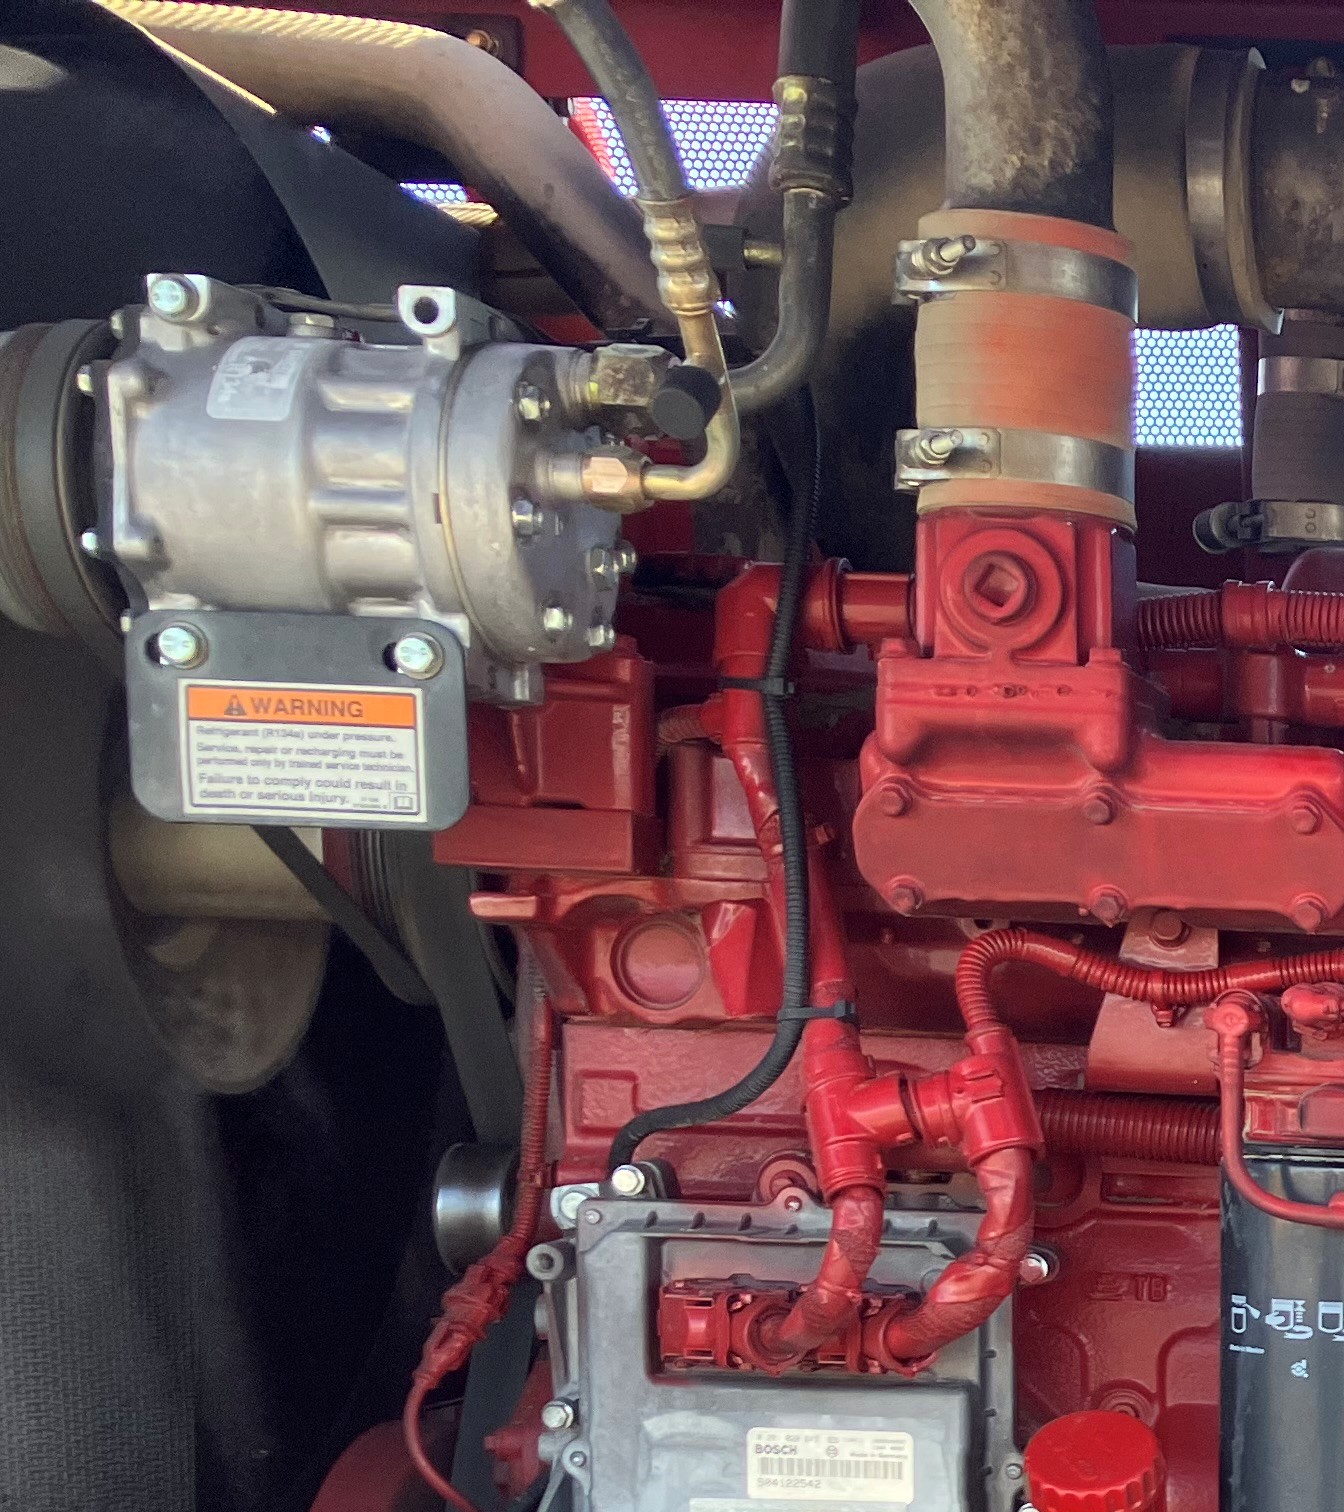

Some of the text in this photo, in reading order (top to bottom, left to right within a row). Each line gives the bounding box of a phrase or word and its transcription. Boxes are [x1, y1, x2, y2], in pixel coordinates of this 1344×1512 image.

[250, 697, 363, 718] WARNING
[308, 730, 339, 740] under
[343, 733, 396, 742] pressure.
[245, 745, 277, 755] repair
[296, 748, 355, 759] recharging
[359, 750, 386, 759] must
[390, 751, 403, 759] be
[200, 773, 407, 790] Failure to comply could result in
[200, 789, 235, 798] death
[258, 791, 304, 801] serious
[310, 792, 349, 805] injury.
[755, 1444, 797, 1455] BOSCH
